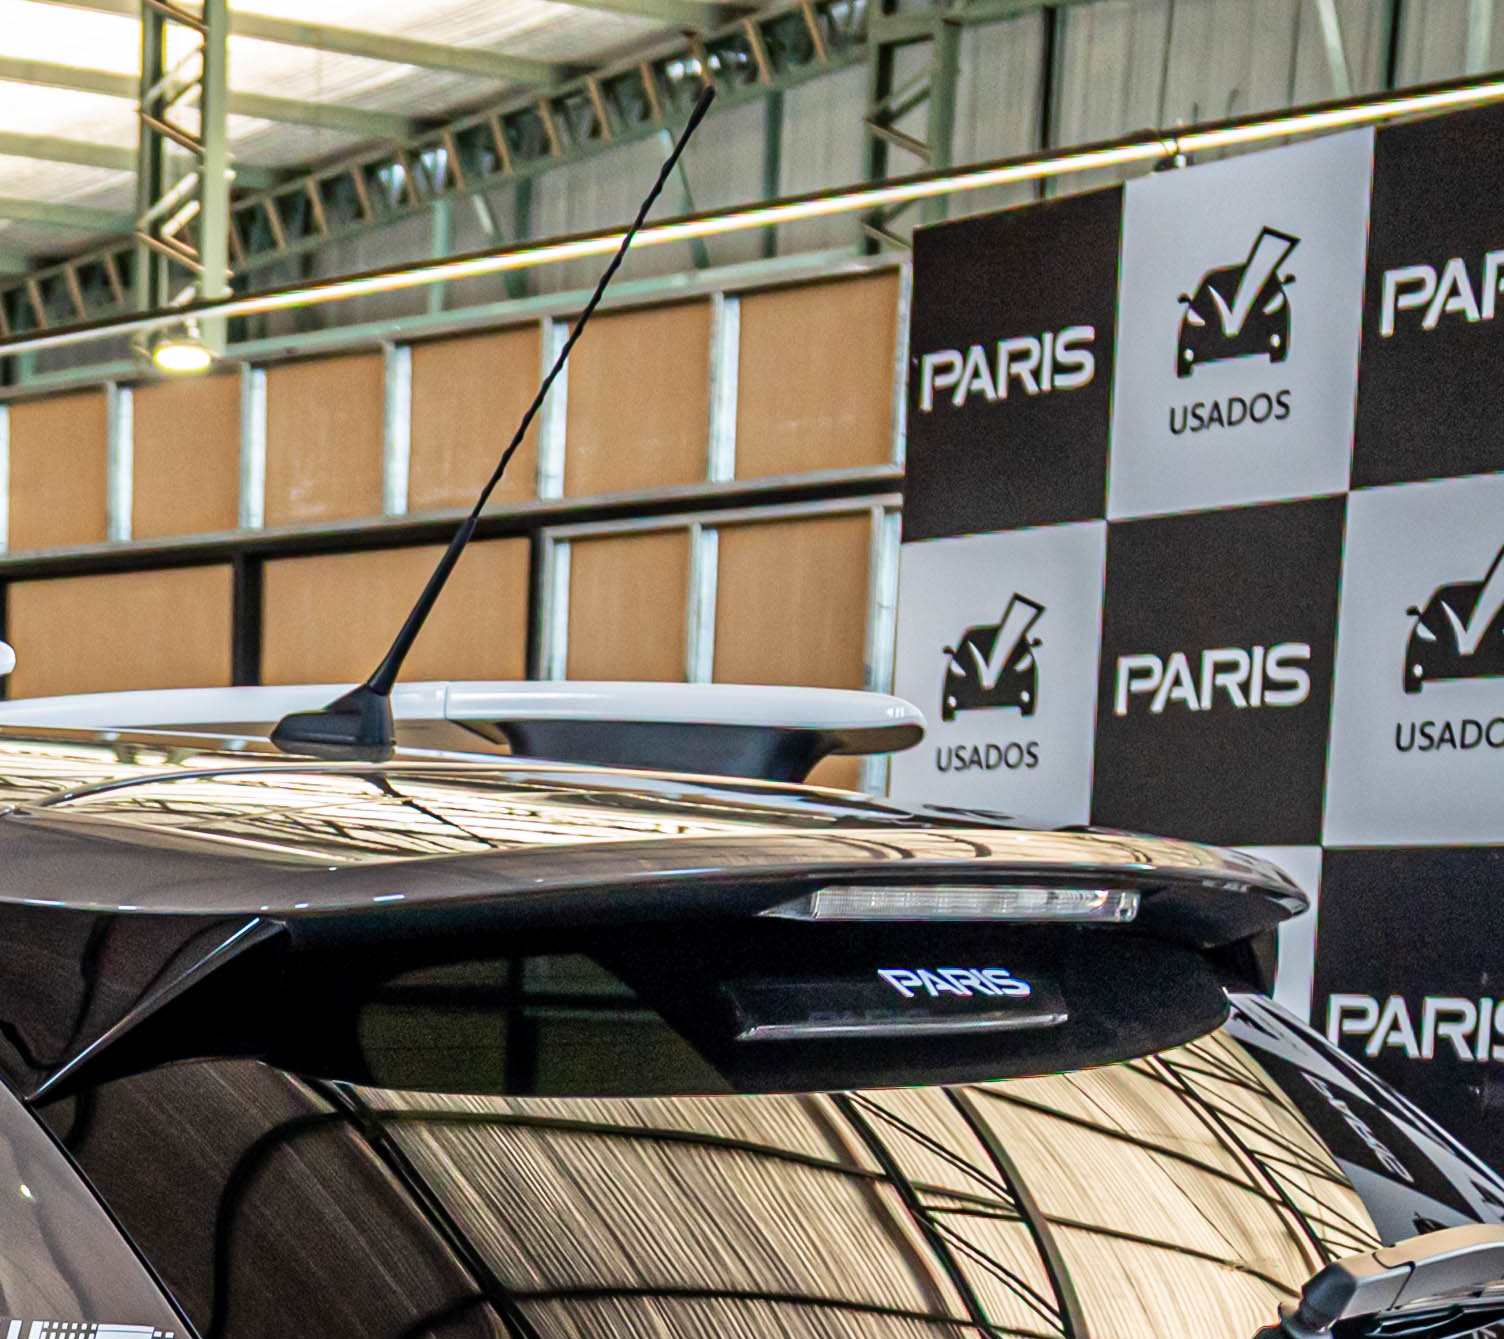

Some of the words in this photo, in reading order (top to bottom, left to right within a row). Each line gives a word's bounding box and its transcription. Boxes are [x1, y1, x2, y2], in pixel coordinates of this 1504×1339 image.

[919, 325, 1095, 411] PARIS
[1169, 389, 1291, 436] USADOS
[1115, 643, 1310, 715] PARIS
[935, 741, 1040, 773] USADOS
[878, 968, 1030, 998] PARIS
